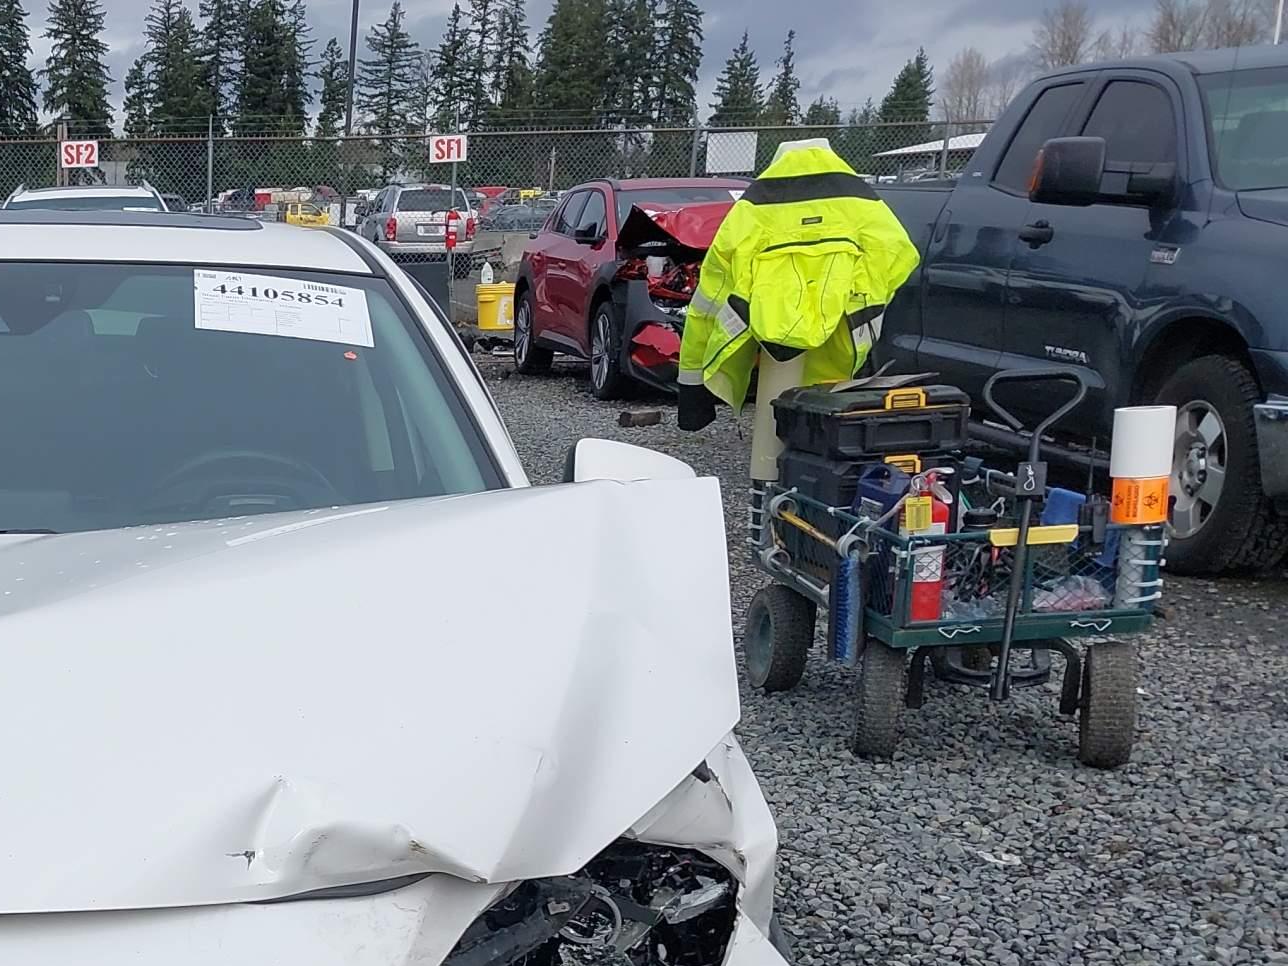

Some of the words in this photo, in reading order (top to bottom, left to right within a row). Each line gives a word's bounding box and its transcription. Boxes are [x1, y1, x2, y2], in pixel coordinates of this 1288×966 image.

[63, 143, 96, 165] SF2
[434, 137, 462, 160] SF1
[212, 283, 345, 308] 44105854
